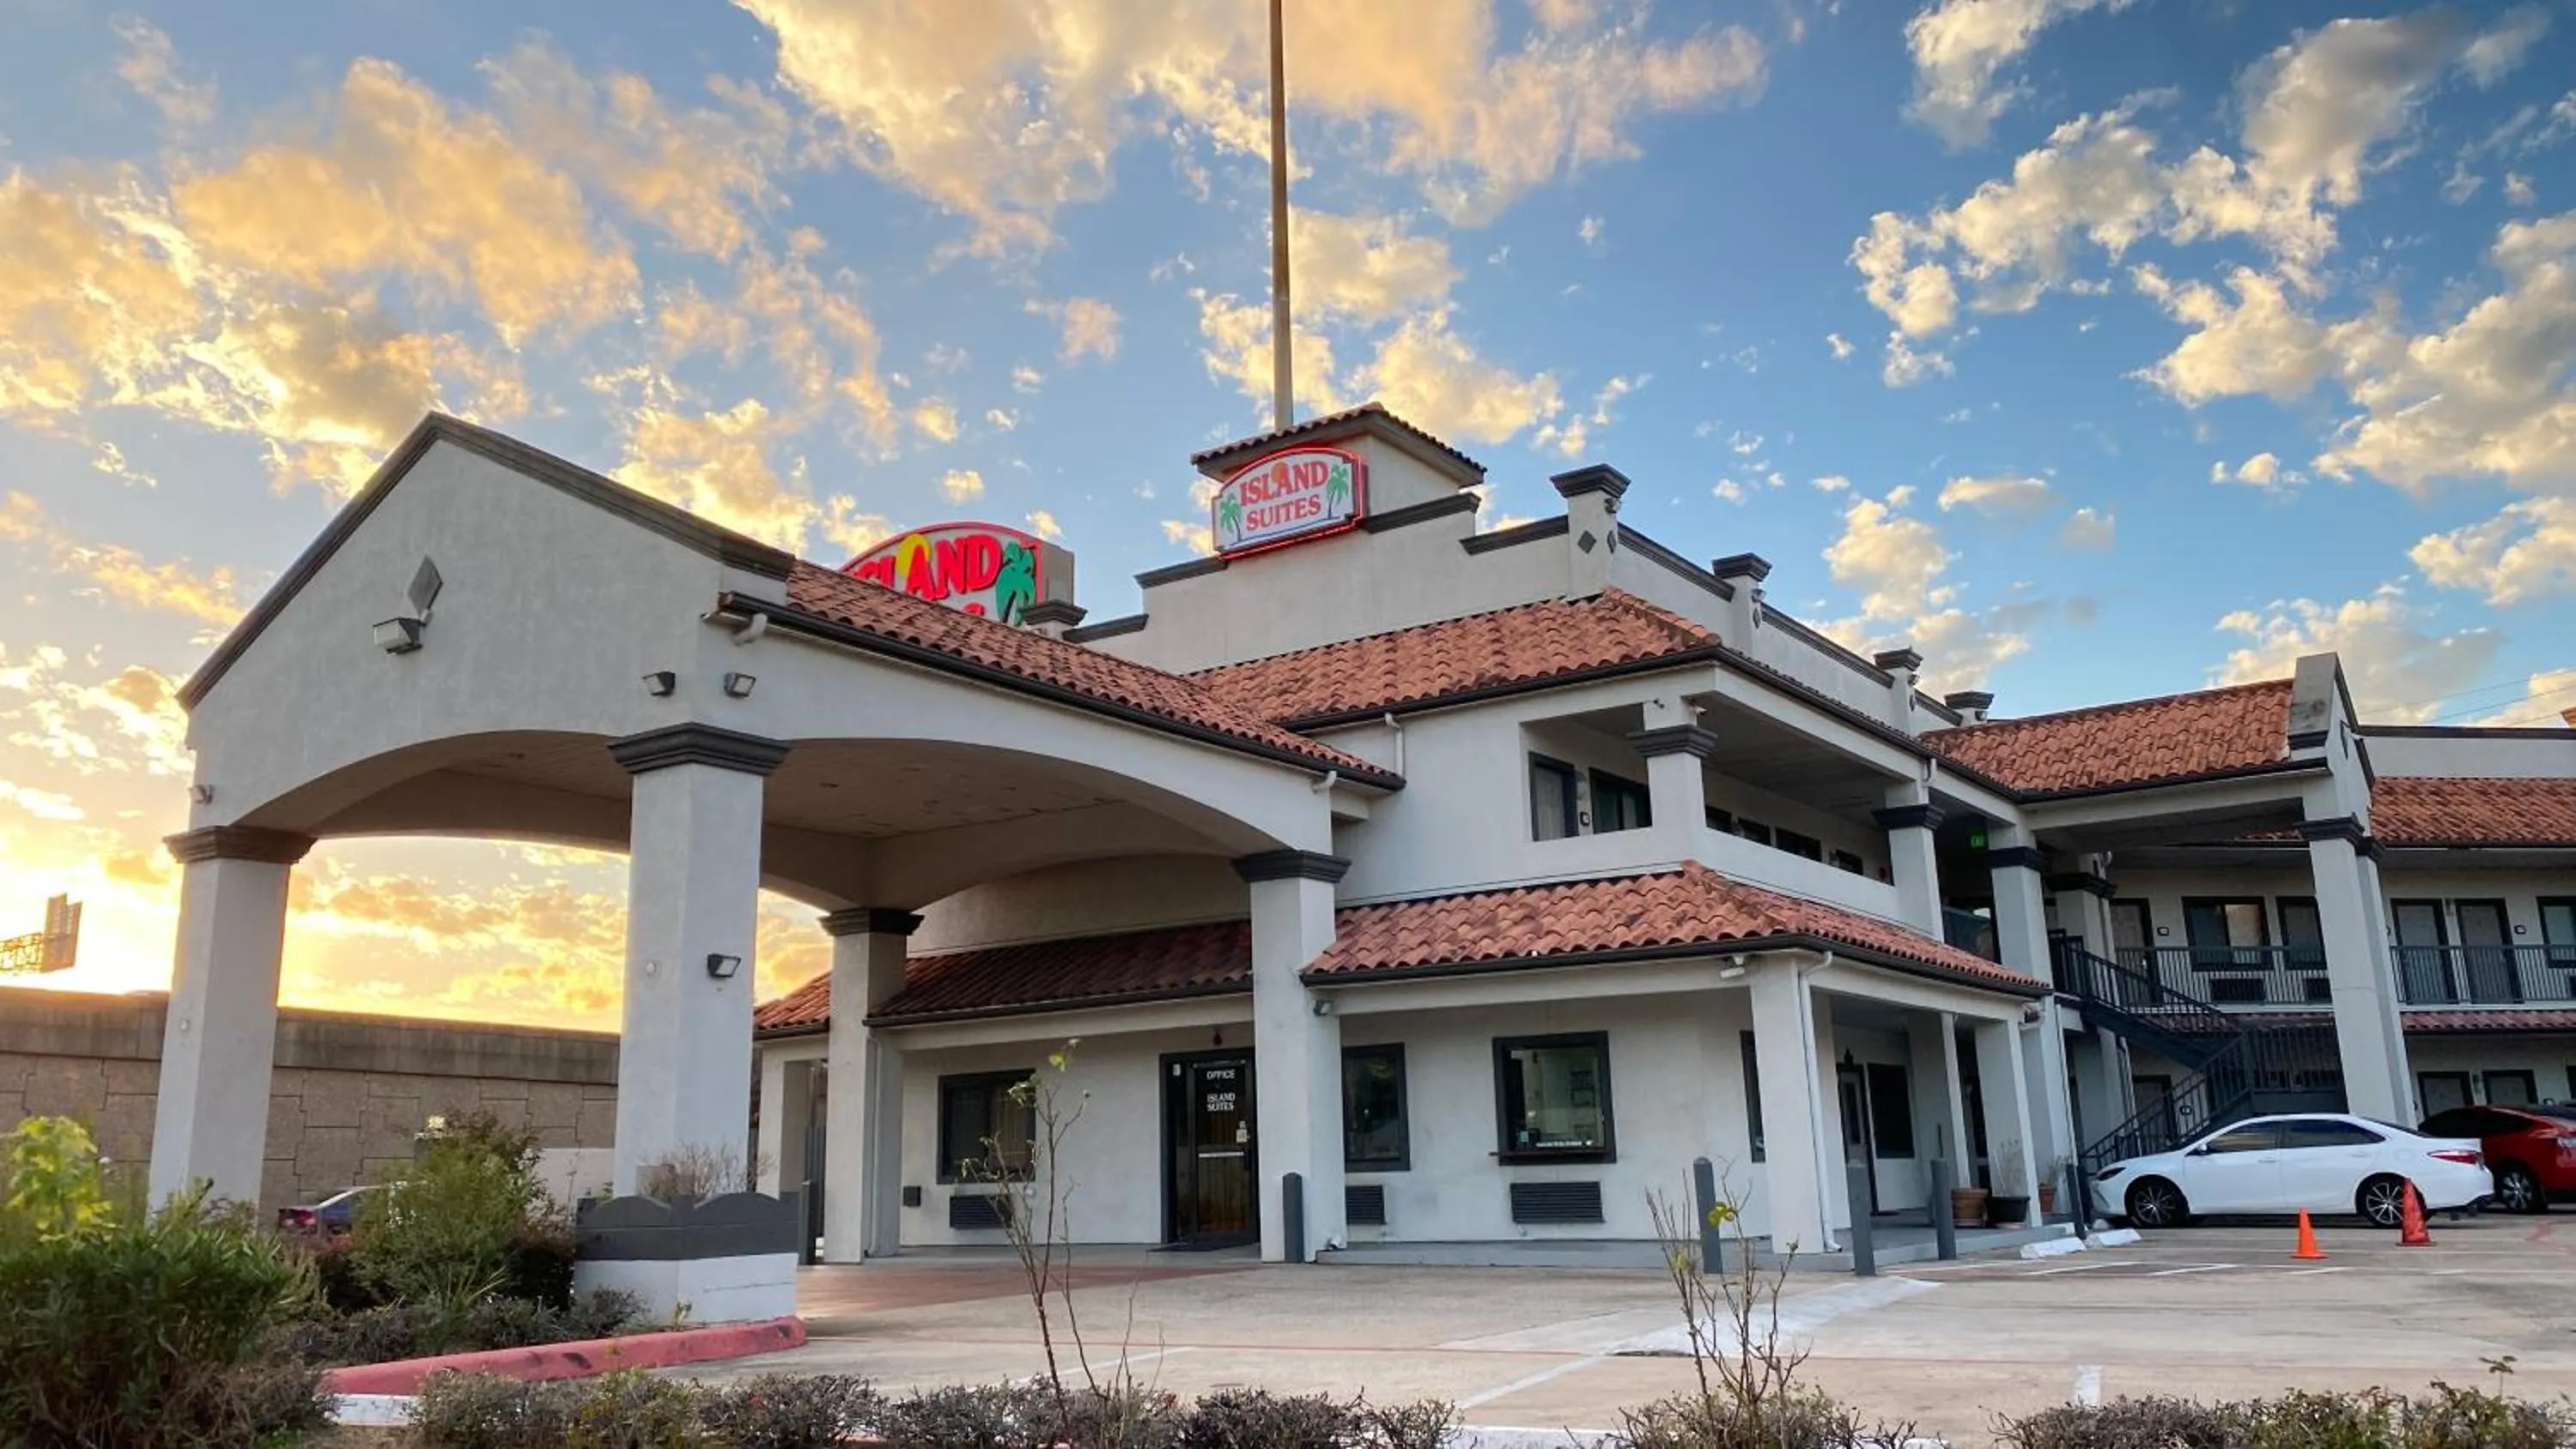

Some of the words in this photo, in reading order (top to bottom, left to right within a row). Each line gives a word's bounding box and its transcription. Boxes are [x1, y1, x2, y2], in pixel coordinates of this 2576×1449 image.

[1239, 460, 1328, 506] ISLAND
[1246, 494, 1321, 531] SUITES
[1206, 1070, 1235, 1080] OFFICE
[1206, 1093, 1236, 1102] ISLAND
[1206, 1101, 1234, 1112] SUITES
